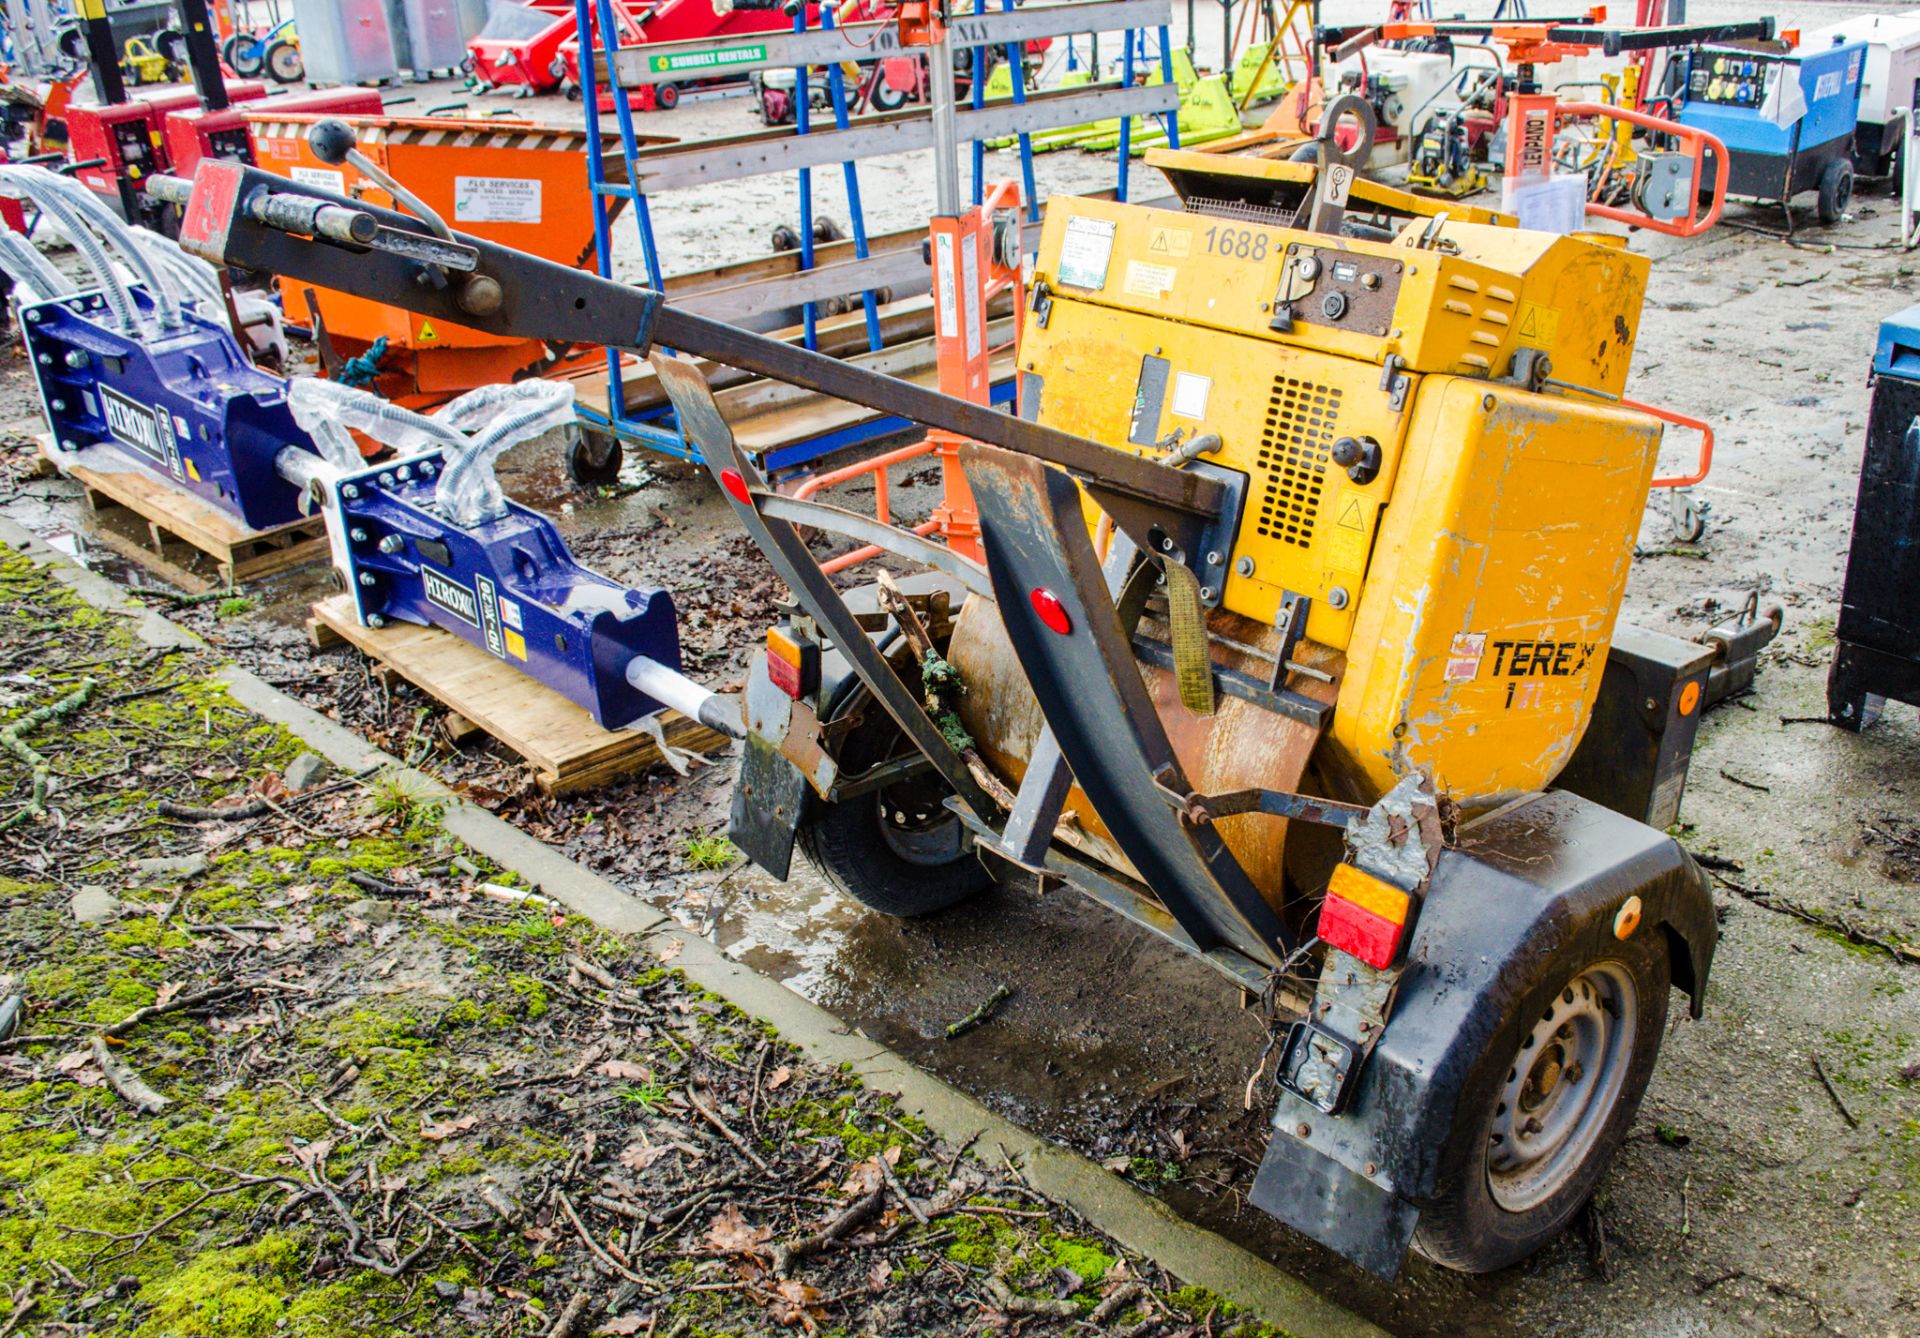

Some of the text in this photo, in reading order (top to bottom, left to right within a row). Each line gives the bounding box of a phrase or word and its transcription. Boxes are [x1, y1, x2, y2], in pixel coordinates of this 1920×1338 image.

[670, 48, 762, 68] SUNBELT RENTALS
[1205, 226, 1269, 262] 1688
[1492, 640, 1596, 677] TEREX
